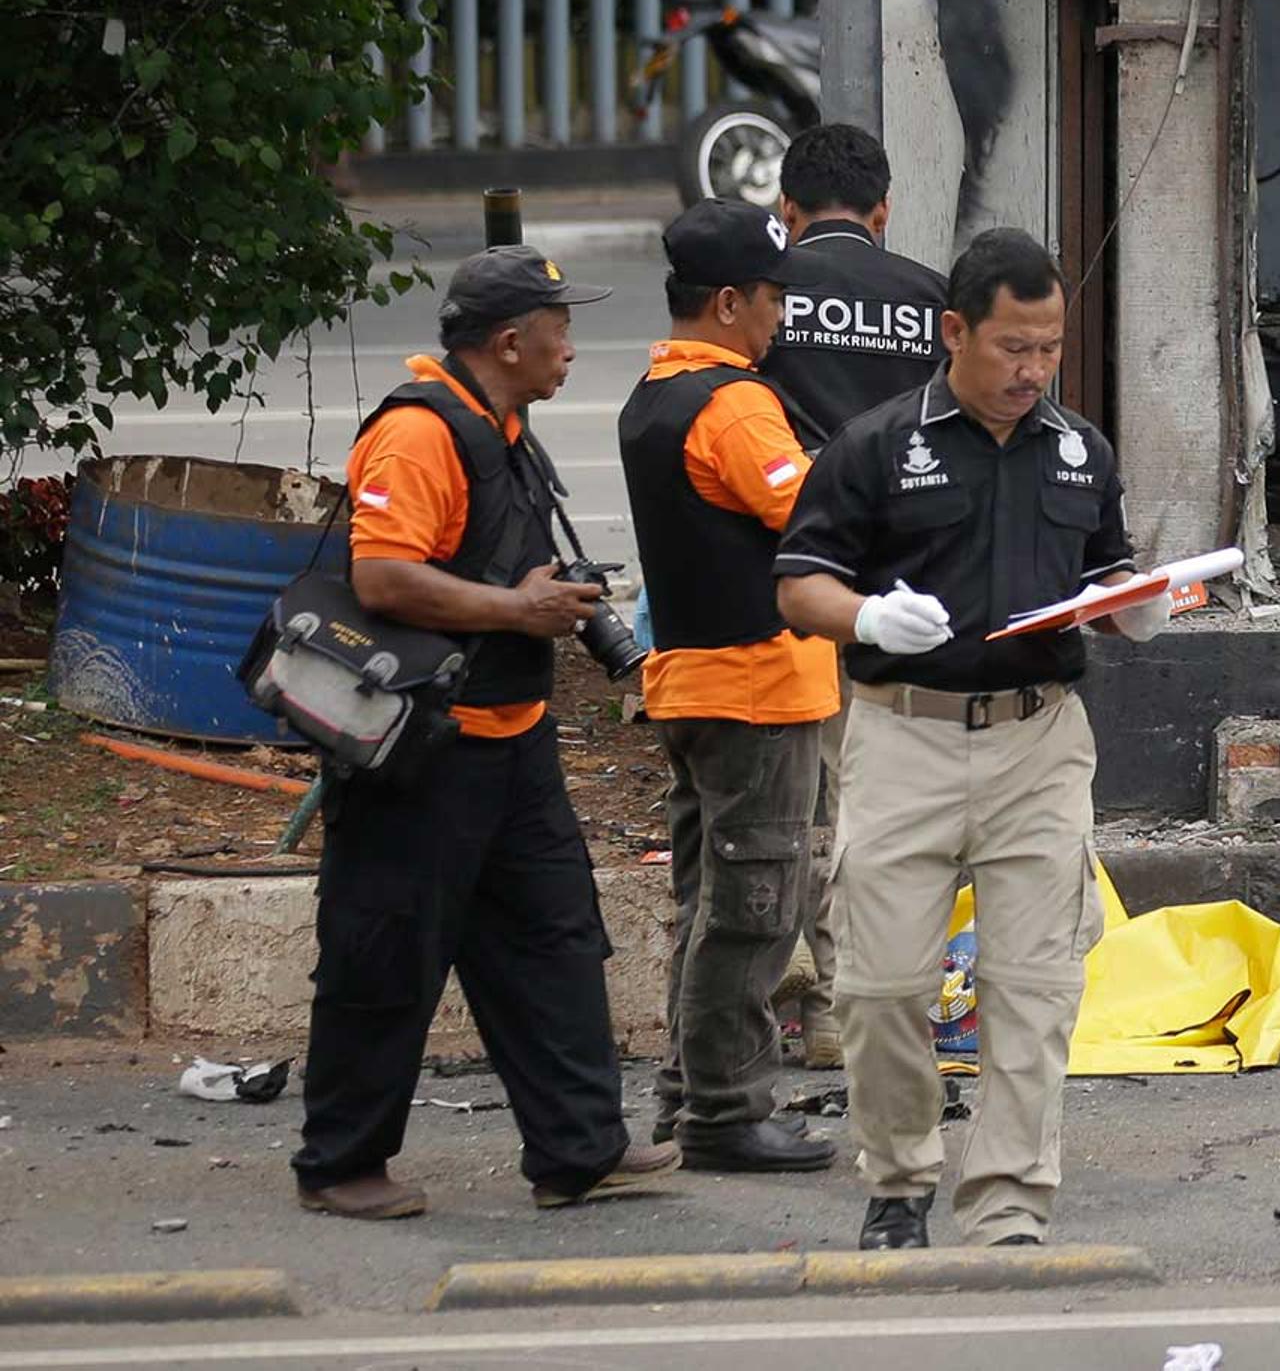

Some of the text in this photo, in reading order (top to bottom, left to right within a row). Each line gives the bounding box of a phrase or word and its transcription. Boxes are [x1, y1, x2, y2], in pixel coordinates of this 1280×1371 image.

[784, 294, 934, 341] POLISI
[785, 329, 932, 355] DIT RESKRIMUM PMJ
[1056, 470, 1094, 485] IDENT
